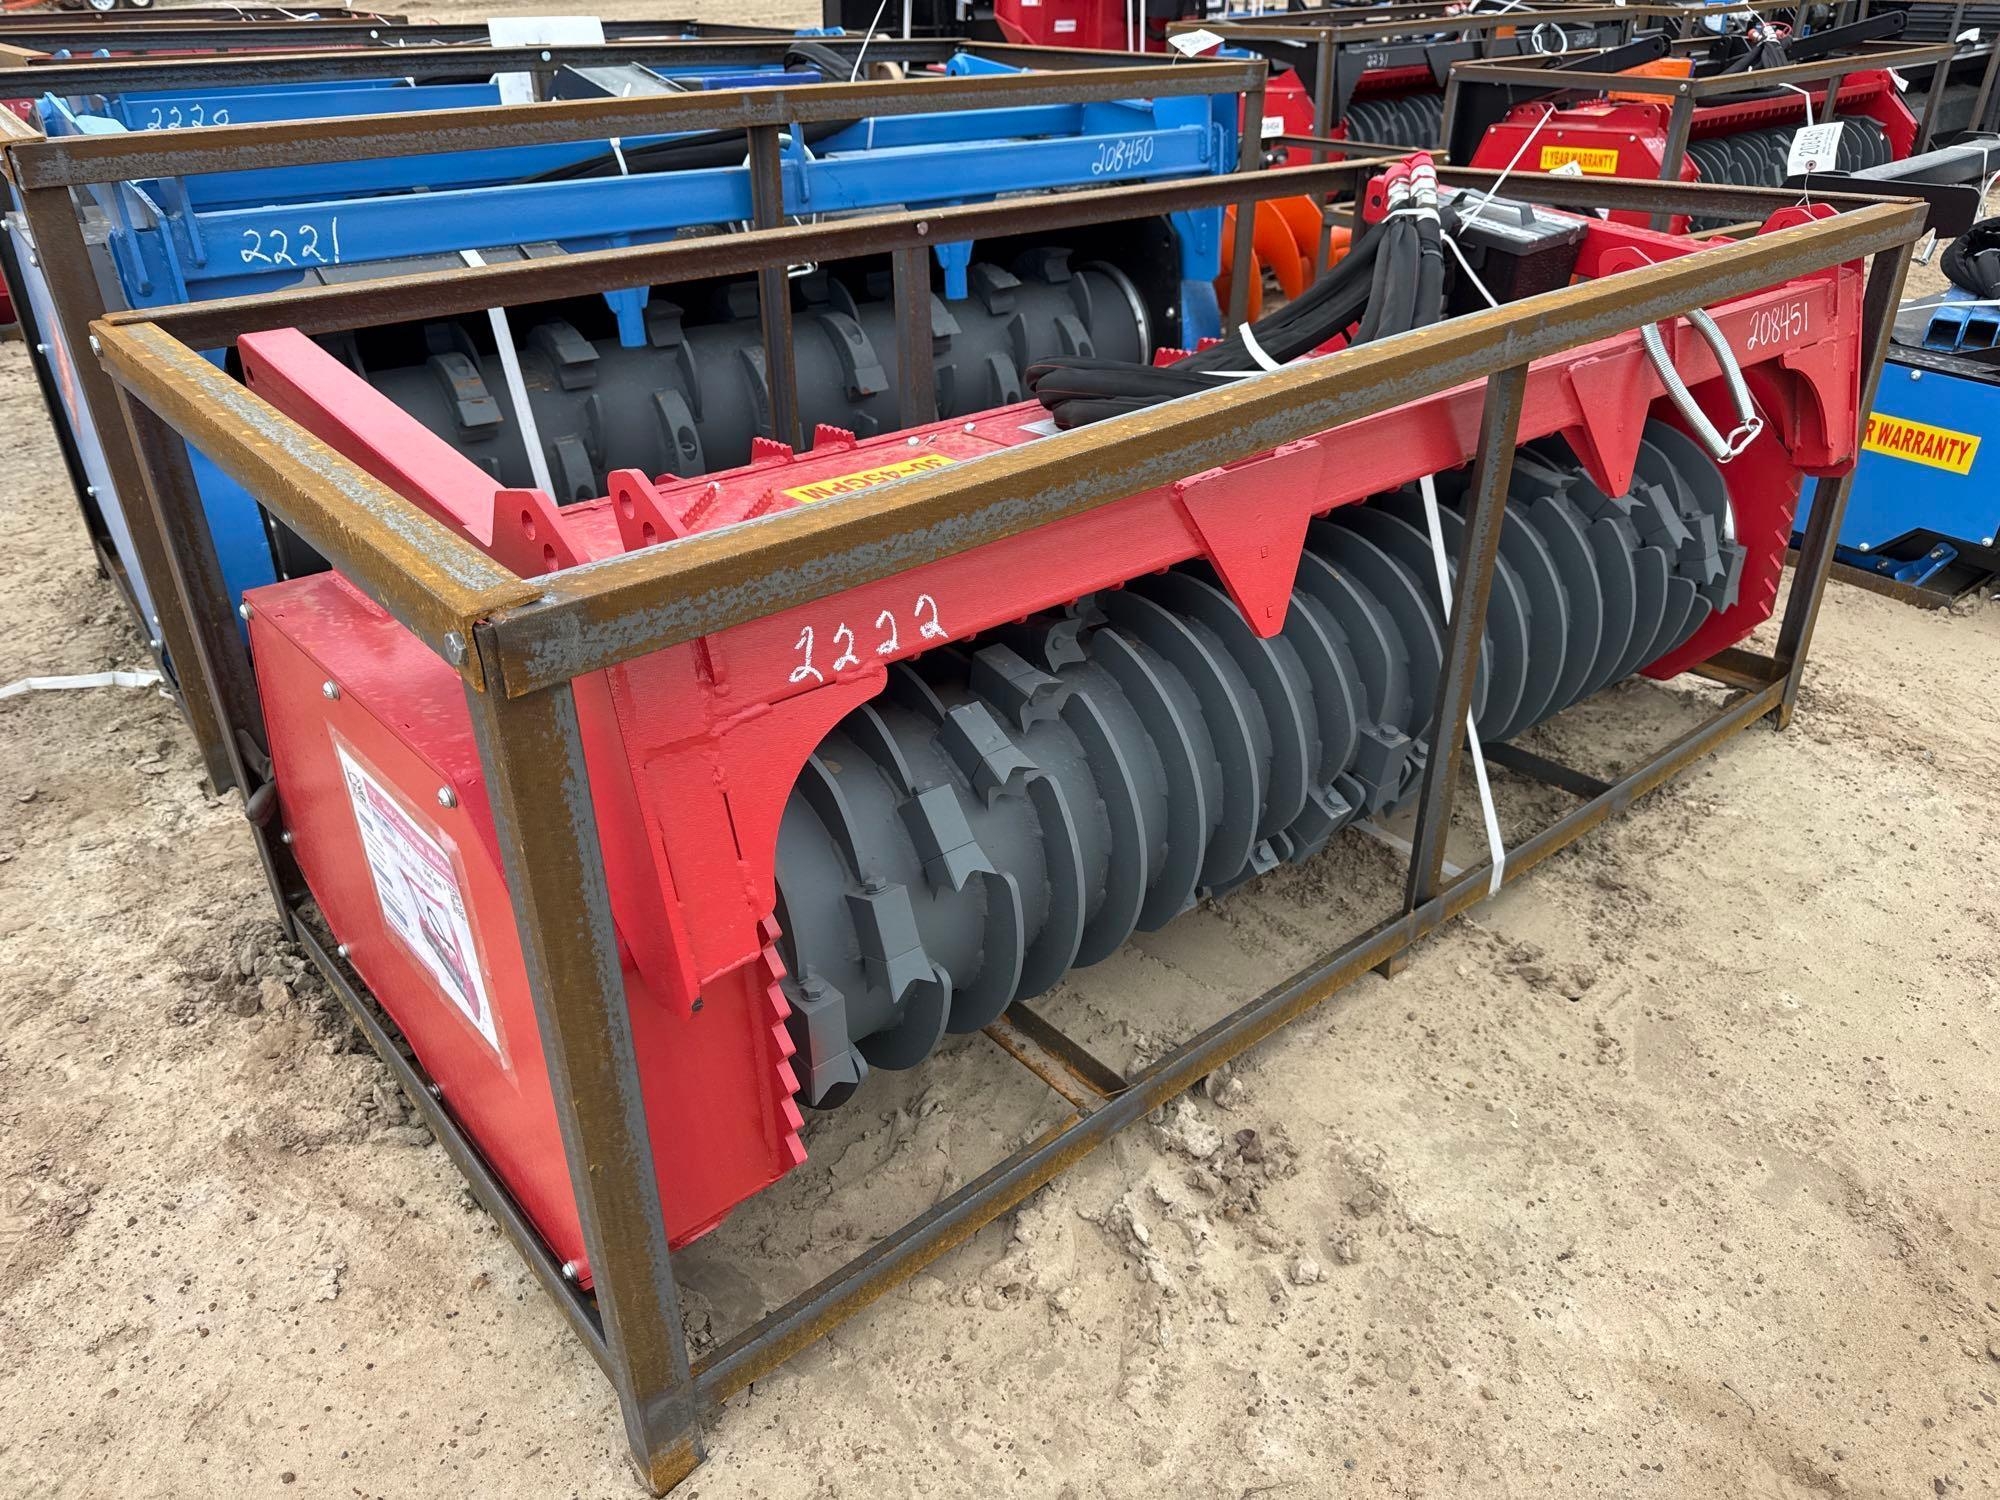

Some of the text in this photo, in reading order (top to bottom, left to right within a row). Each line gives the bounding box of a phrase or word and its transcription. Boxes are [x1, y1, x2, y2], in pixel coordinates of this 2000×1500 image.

[147, 104, 229, 130] 2220
[1092, 136, 1154, 175] 208450
[1550, 151, 1570, 166] YEAR
[1571, 152, 1615, 169] WARRANTY
[241, 217, 340, 266] 2221
[1747, 302, 1808, 350] 208451
[1877, 421, 1971, 466] WARRANTY
[788, 594, 949, 683] 2222
